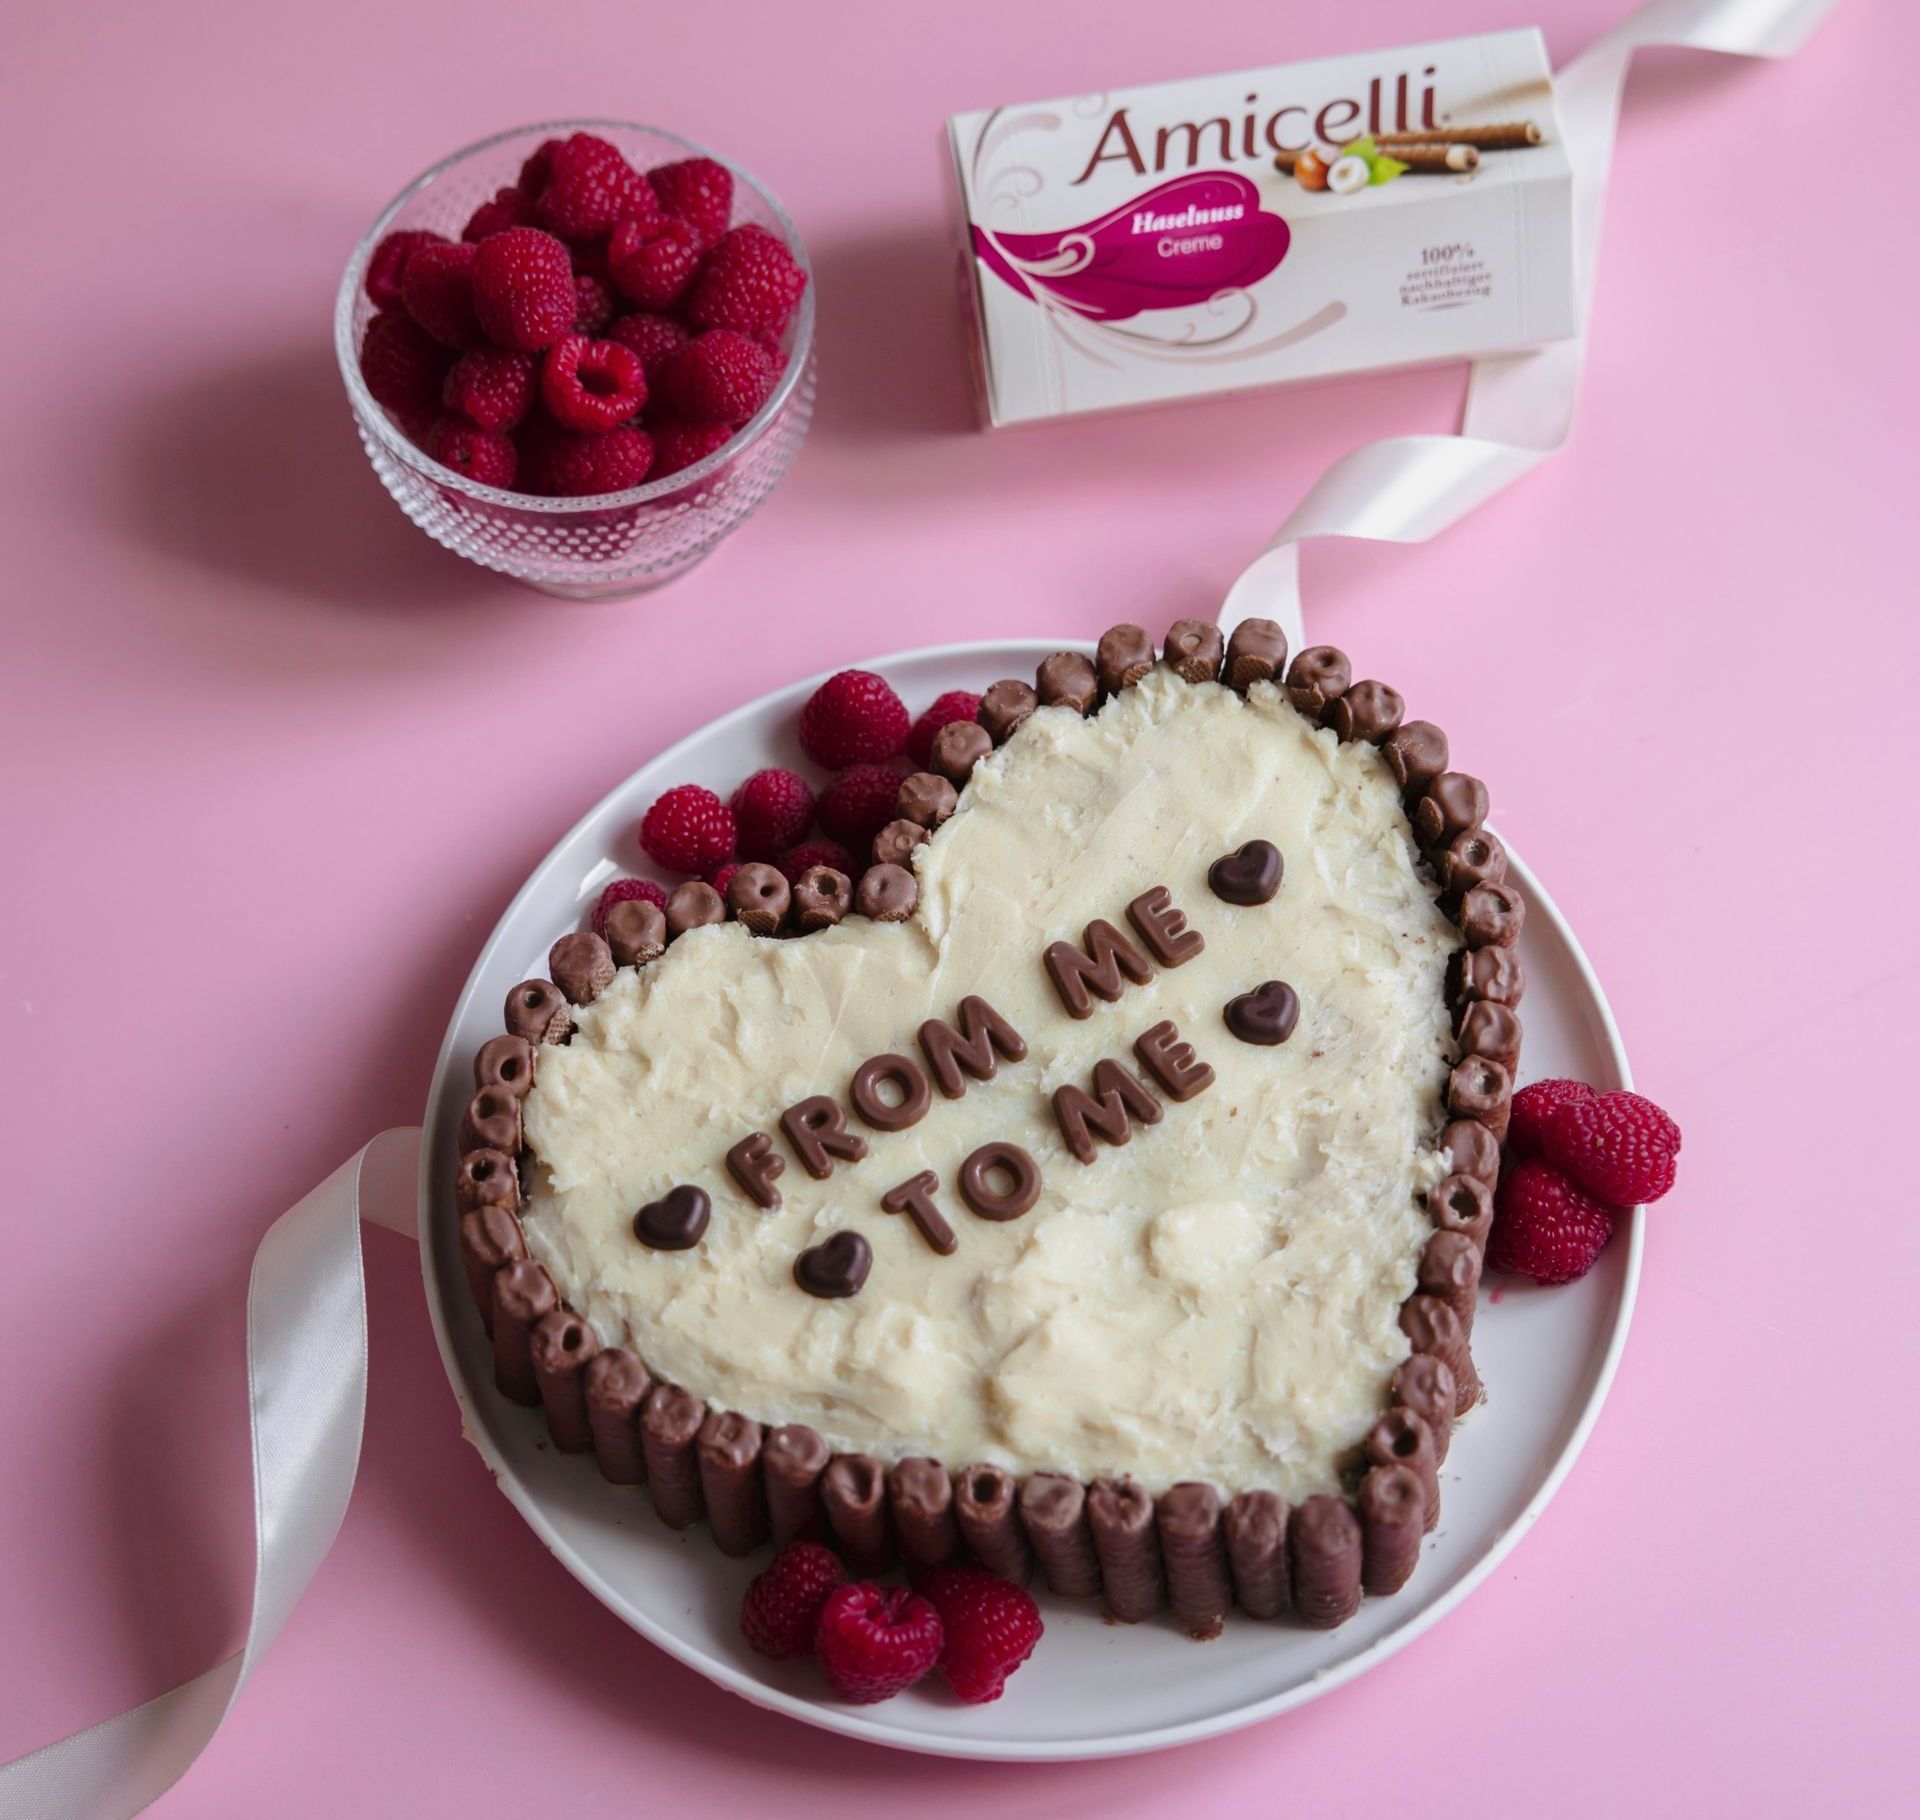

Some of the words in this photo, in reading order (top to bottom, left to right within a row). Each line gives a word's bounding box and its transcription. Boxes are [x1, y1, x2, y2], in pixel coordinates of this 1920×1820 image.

[1070, 65, 1437, 186] Amicelli
[1131, 203, 1244, 236] Haselnuss
[1157, 233, 1223, 259] Creme
[1422, 242, 1474, 265] 100%
[725, 995, 1028, 1210] FROM
[1044, 886, 1205, 1019] ME
[881, 1142, 1042, 1255] TO
[1052, 1020, 1216, 1164] ME
